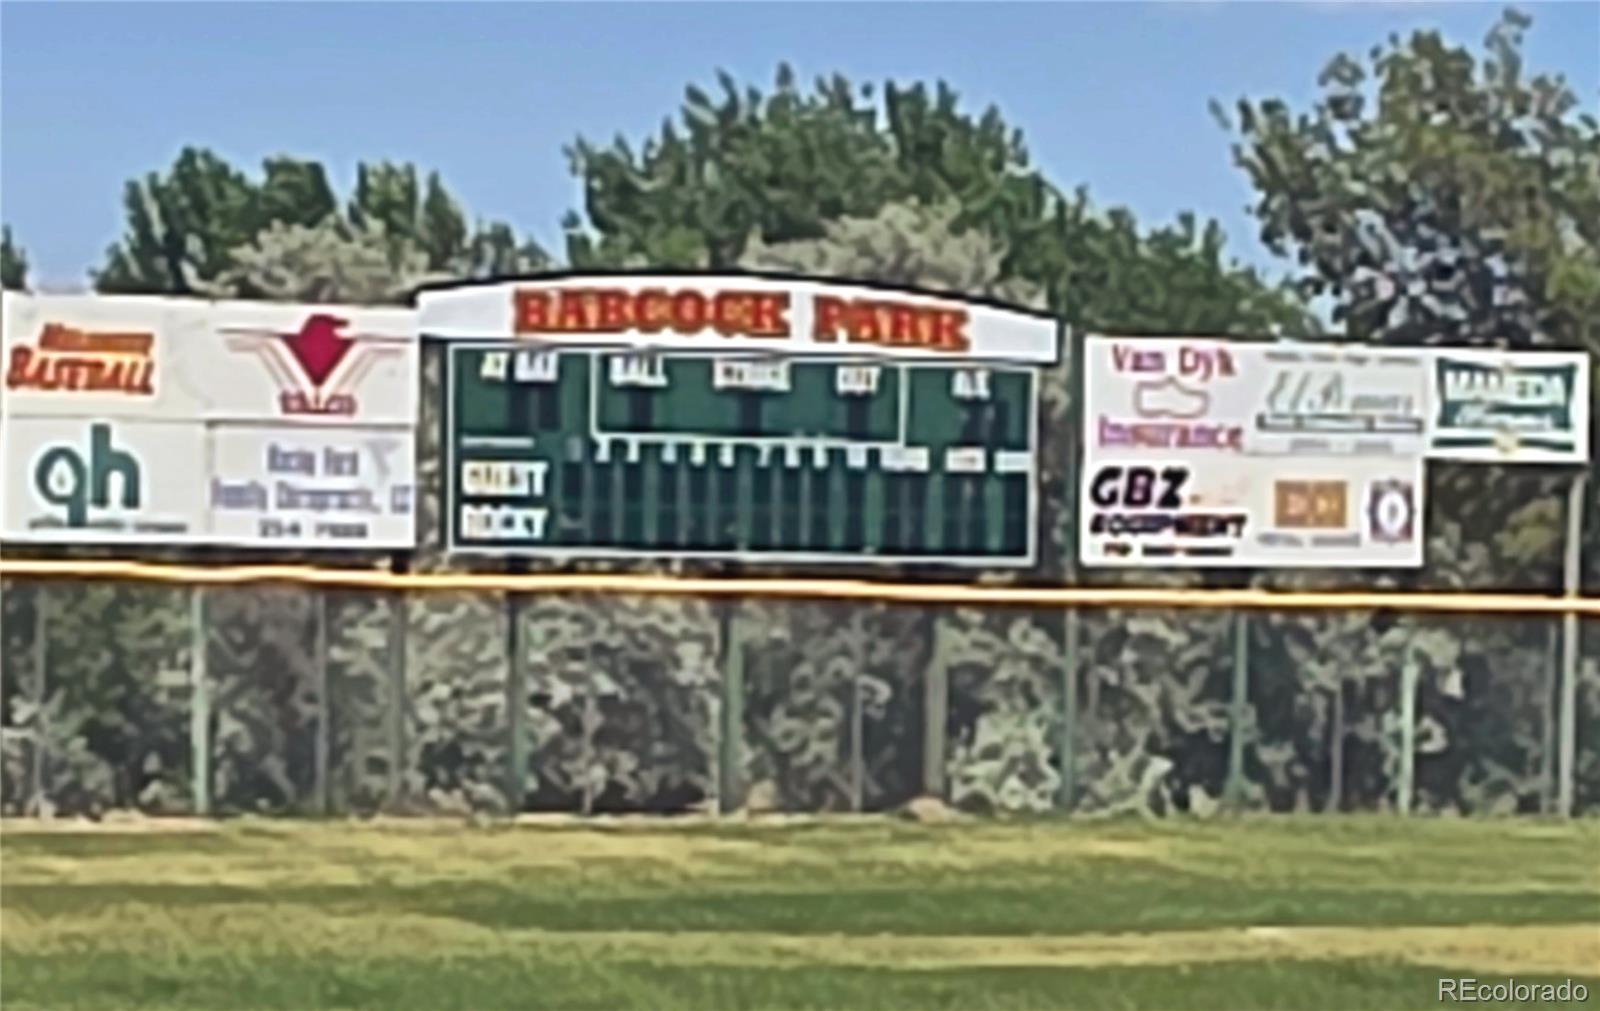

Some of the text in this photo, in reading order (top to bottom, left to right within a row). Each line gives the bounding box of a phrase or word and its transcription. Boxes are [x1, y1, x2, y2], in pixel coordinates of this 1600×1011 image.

[513, 287, 971, 353] BABCOCK PARK
[1111, 343, 1166, 372] Van
[1098, 414, 1244, 453] Insurance
[1089, 466, 1190, 508] GBZ
